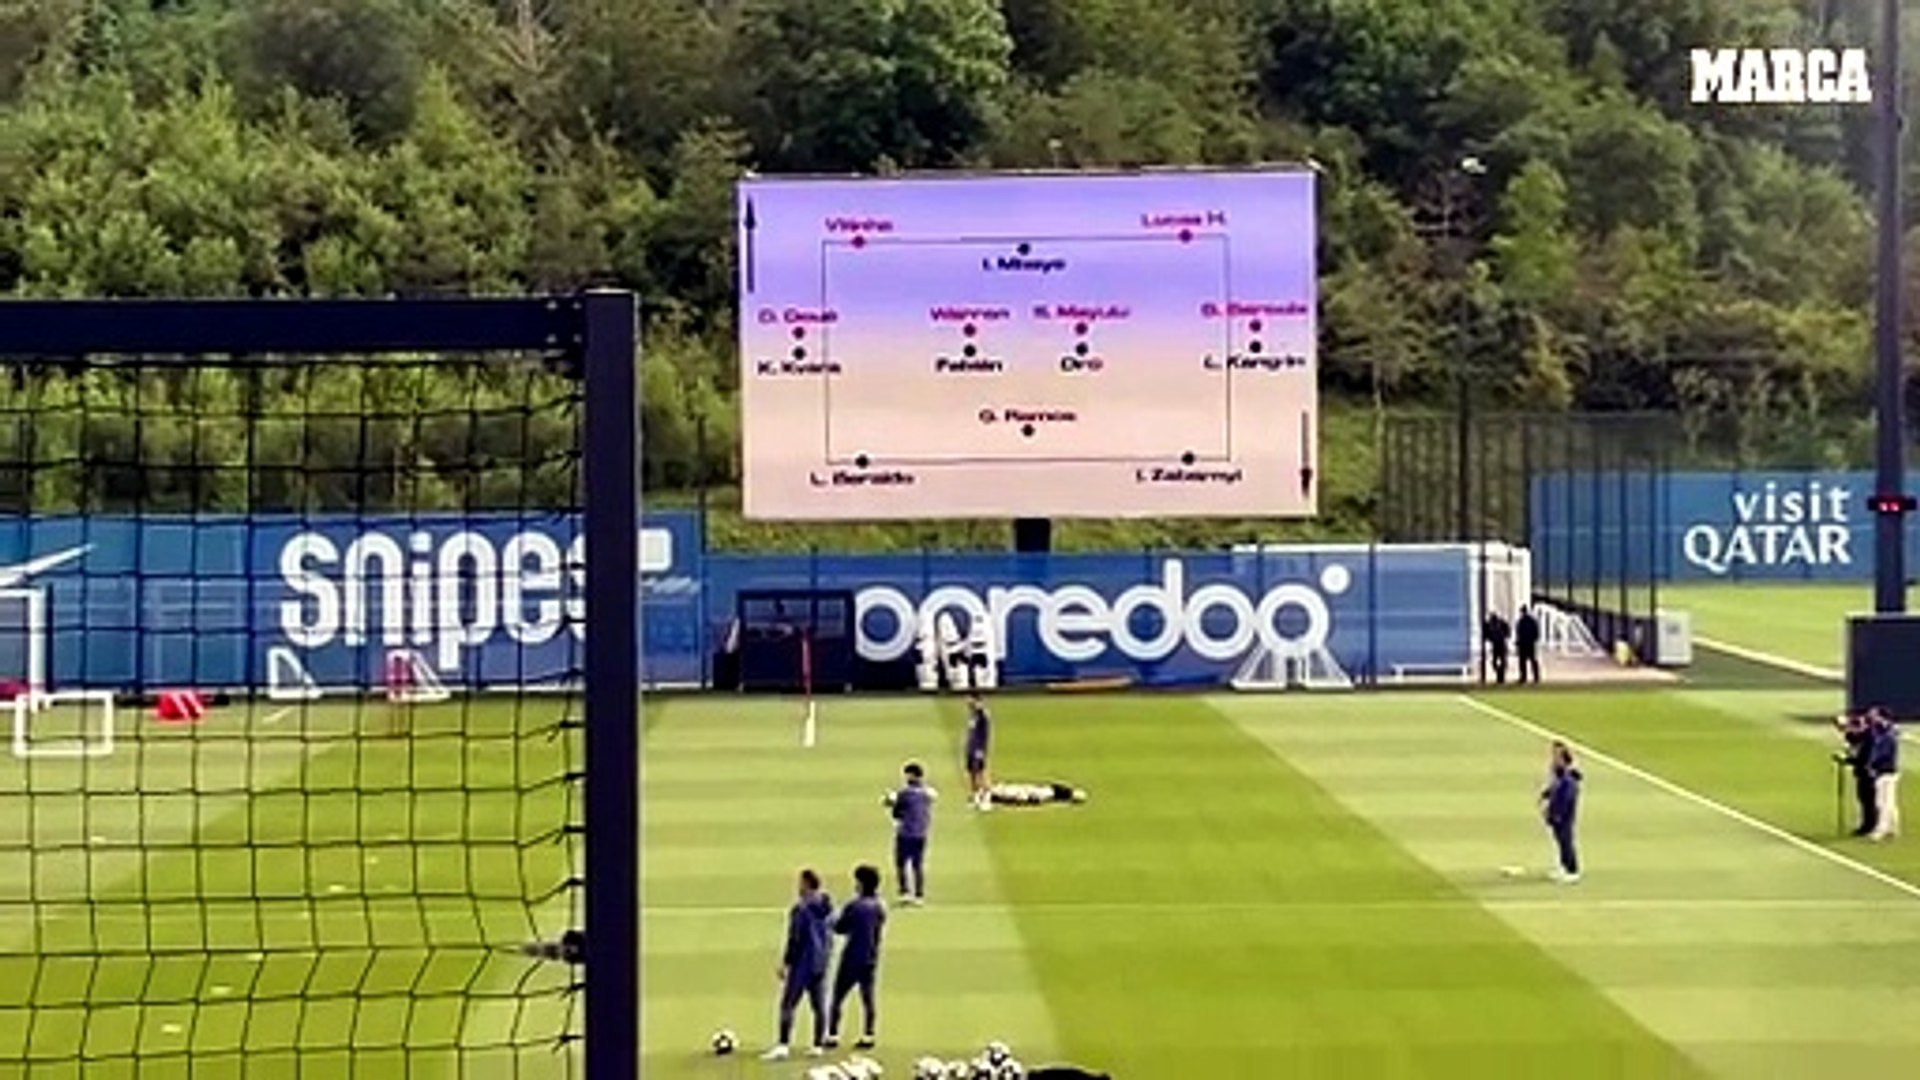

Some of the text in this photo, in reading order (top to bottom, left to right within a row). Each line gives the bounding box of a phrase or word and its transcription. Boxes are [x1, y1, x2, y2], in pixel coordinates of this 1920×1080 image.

[1734, 481, 1851, 523] visit
[1684, 525, 1852, 573] QATAR
[855, 558, 1331, 661] ooredoo
